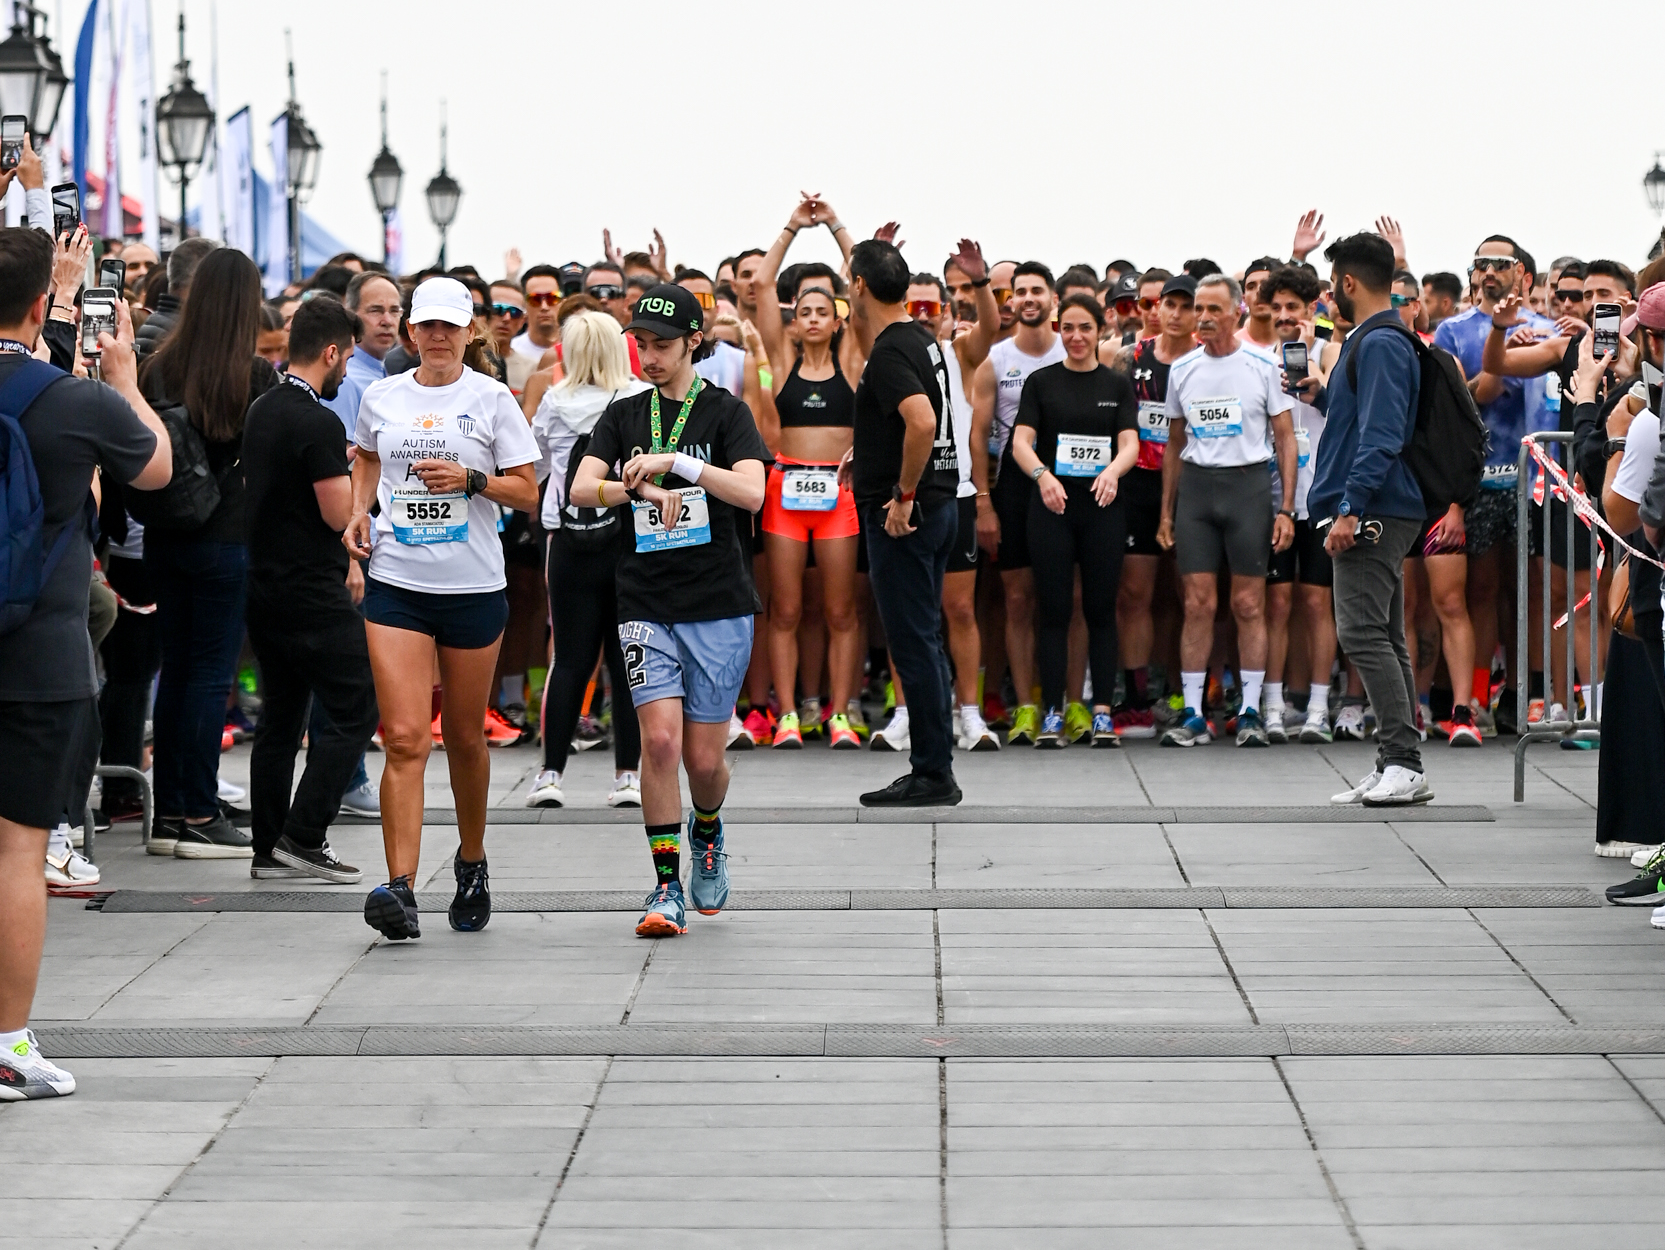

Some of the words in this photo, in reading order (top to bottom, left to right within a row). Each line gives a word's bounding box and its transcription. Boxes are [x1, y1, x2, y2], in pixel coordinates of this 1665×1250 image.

[1149, 413, 1170, 427] 571
[1200, 408, 1230, 421] 5054
[402, 438, 446, 449] AUTISM
[389, 450, 459, 462] AWARENESS
[1070, 447, 1101, 460] 5372
[796, 481, 827, 493] 5683
[680, 489, 703, 498] MOUR
[406, 501, 452, 520] 5552
[648, 504, 692, 526] 52
[412, 527, 424, 536] 5K
[426, 527, 447, 535] RUN
[655, 533, 667, 542] 5K
[669, 530, 689, 540] RUN
